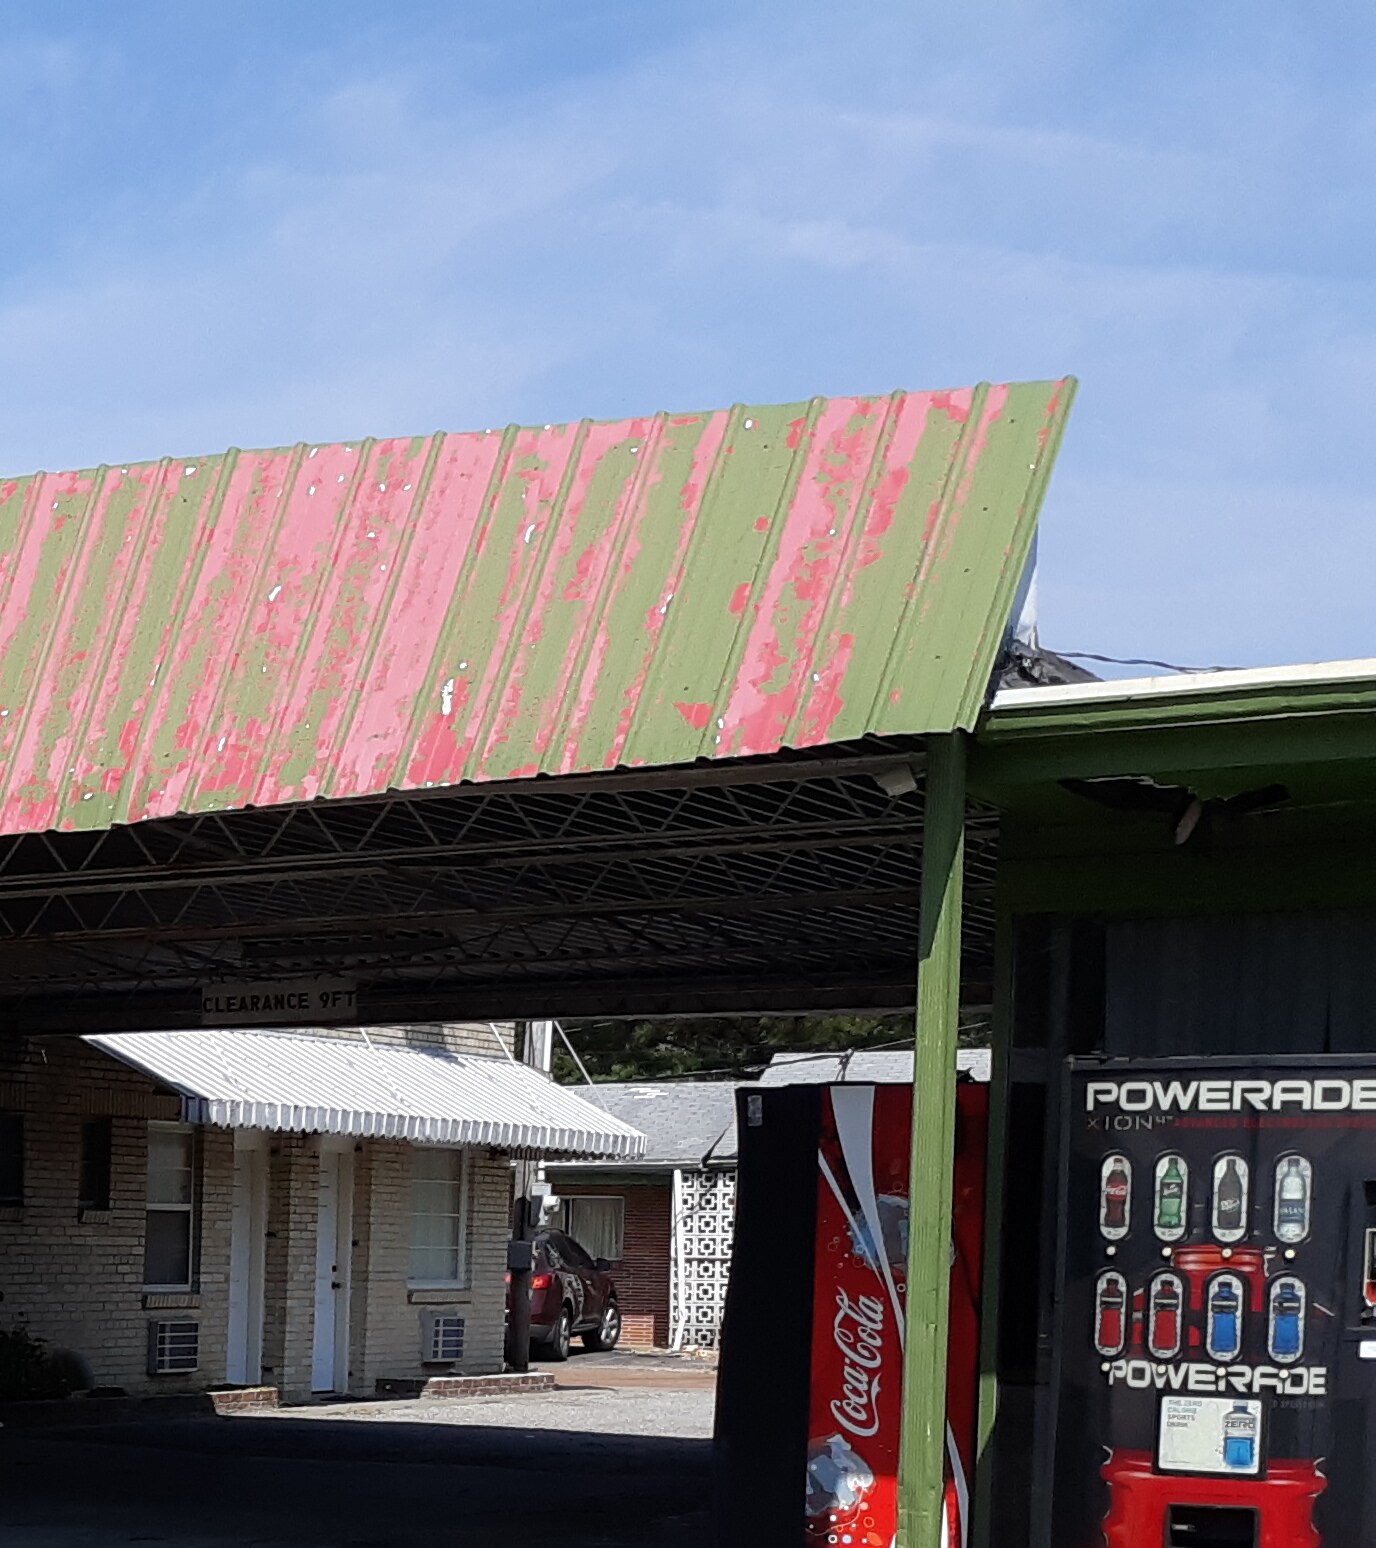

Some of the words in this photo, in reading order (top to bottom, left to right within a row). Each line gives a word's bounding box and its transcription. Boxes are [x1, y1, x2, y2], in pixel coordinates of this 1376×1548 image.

[202, 992, 310, 1014] CLEARANCE
[319, 990, 356, 1009] 9FT
[1086, 1080, 1376, 1111] POWERADE
[1107, 1359, 1327, 1395] POWERADE
